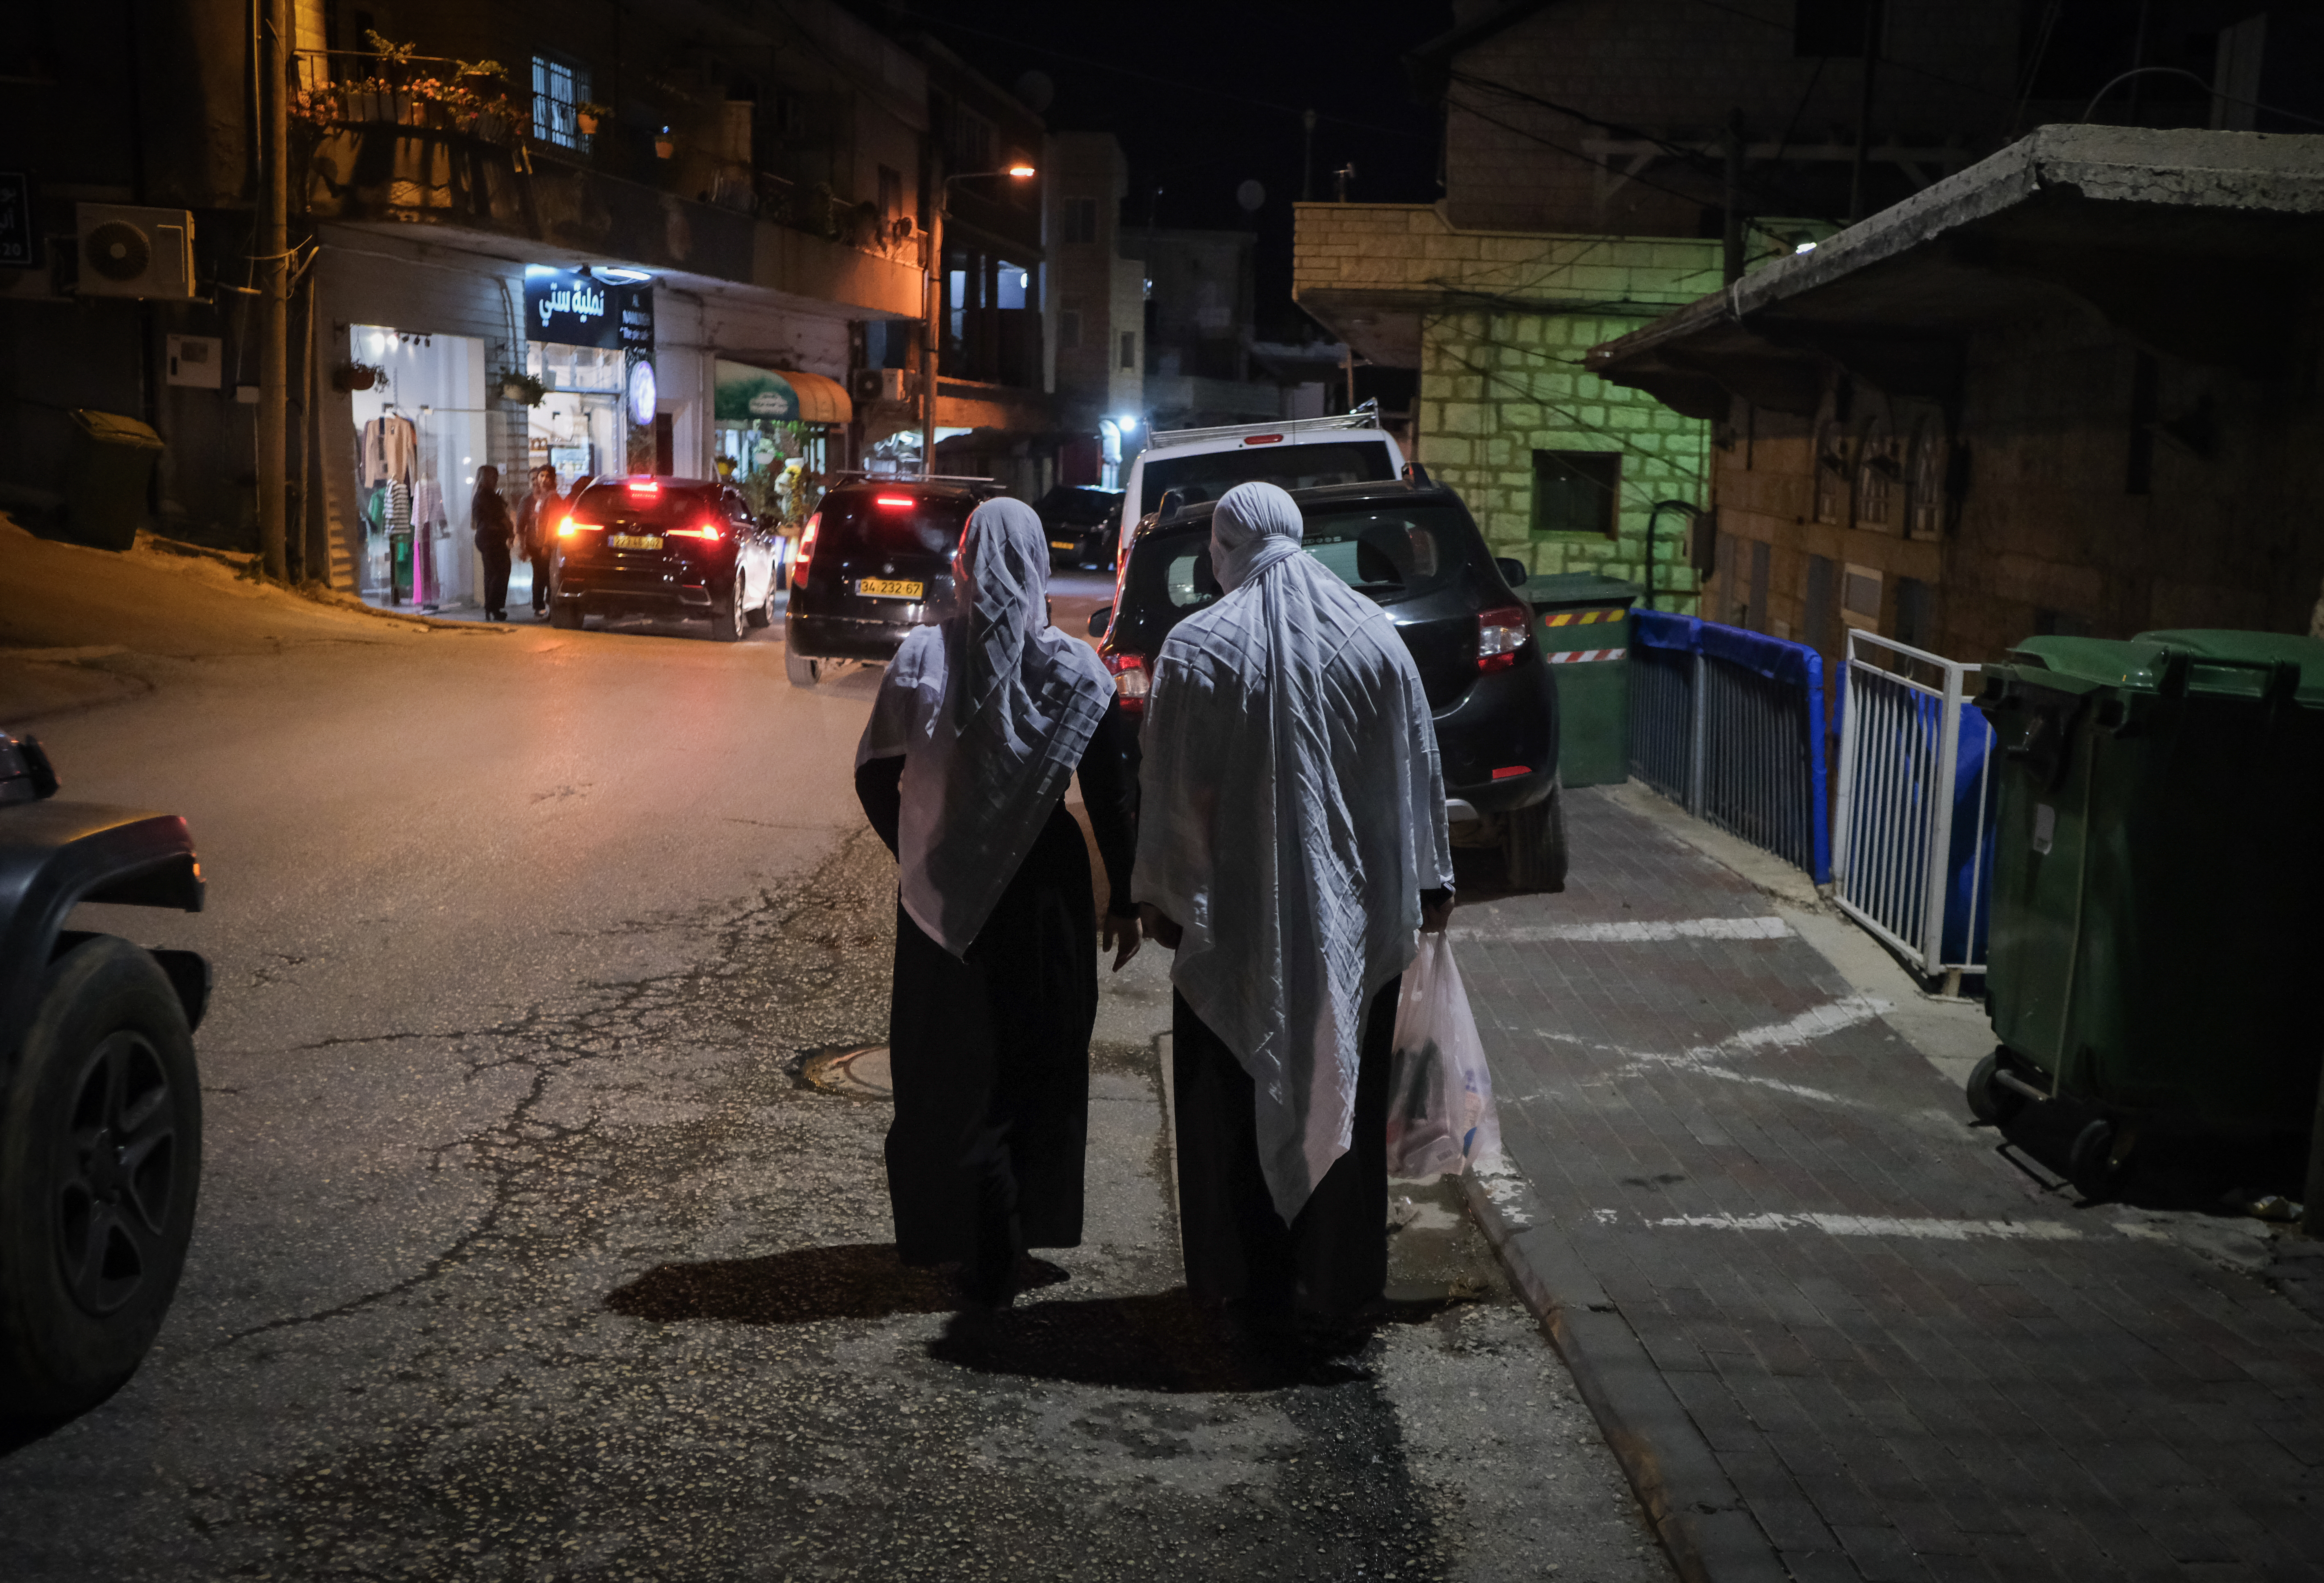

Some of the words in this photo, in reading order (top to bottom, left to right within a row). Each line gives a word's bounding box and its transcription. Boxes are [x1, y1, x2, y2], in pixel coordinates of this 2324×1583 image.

[0, 242, 22, 256] 20
[539, 282, 571, 327] ستي
[572, 280, 604, 323] نملية
